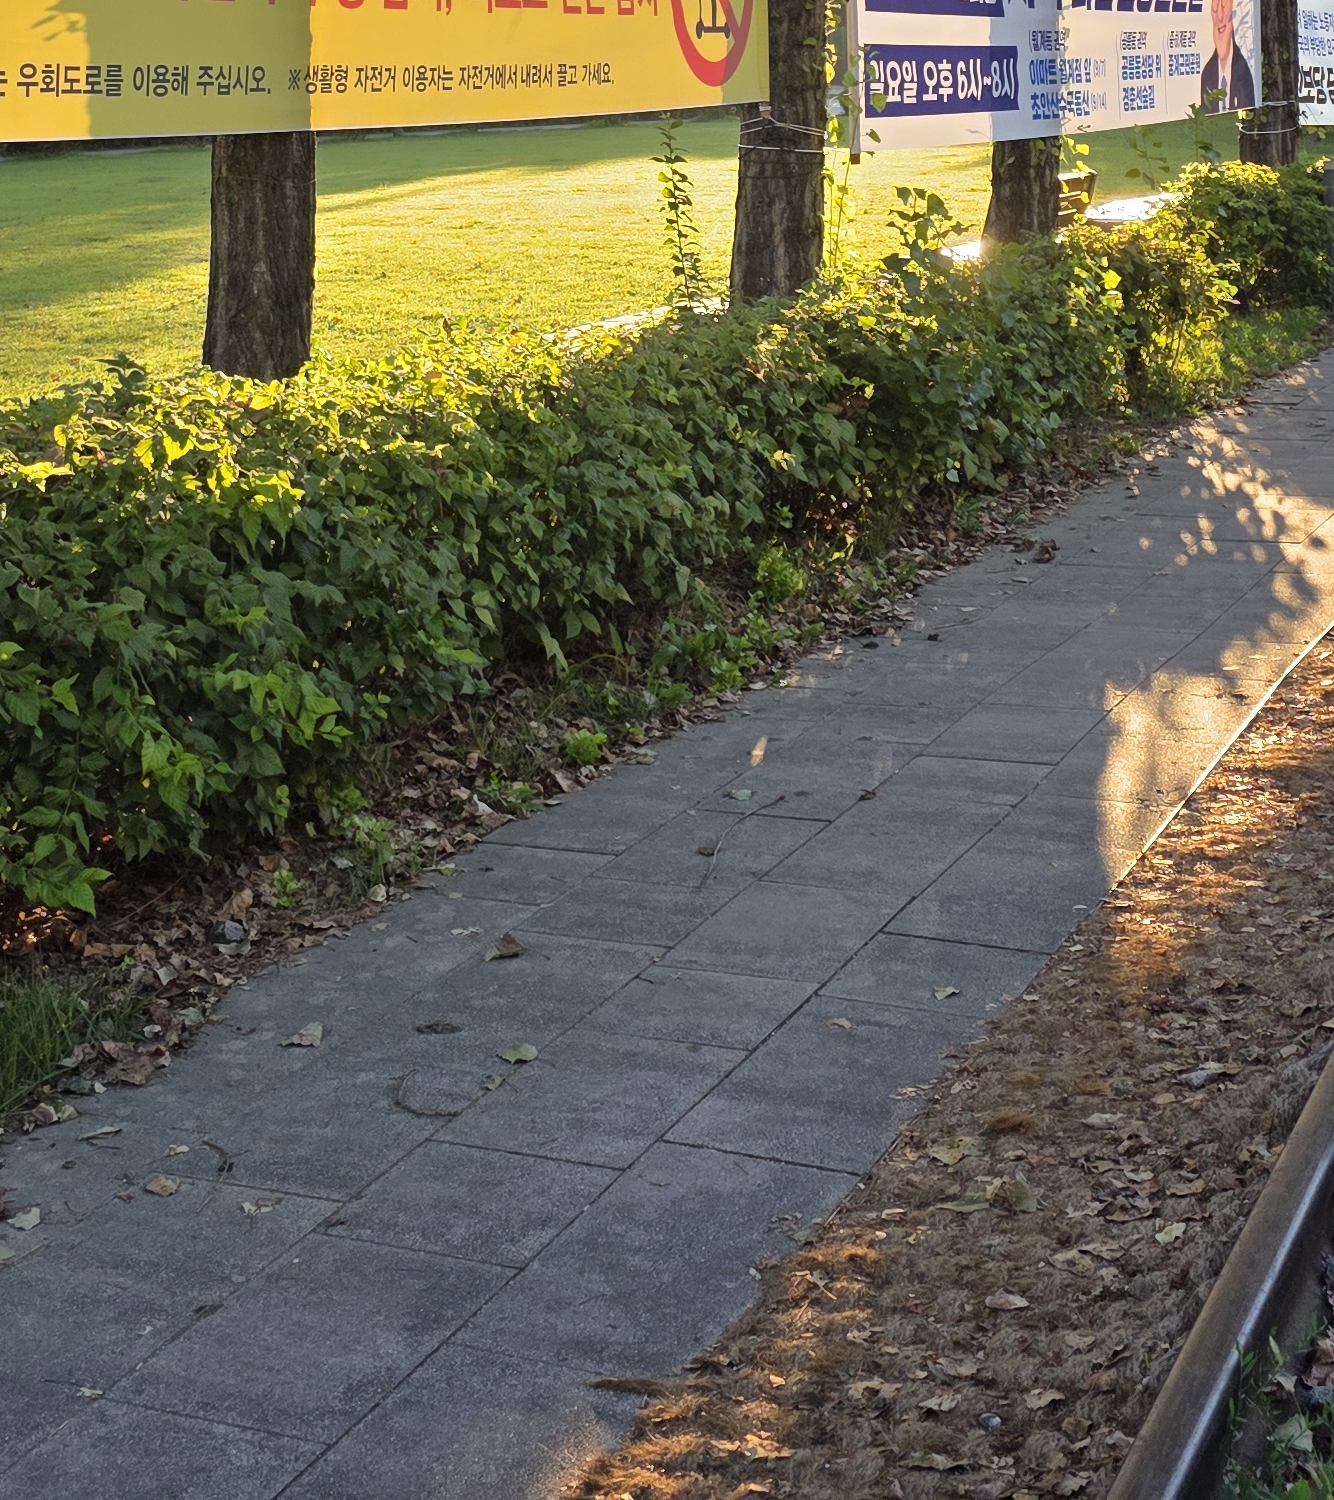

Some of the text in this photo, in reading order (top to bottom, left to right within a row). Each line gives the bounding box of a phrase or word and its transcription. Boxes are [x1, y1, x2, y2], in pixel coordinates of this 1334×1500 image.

[354, 64, 398, 94] 자전거
[402, 65, 454, 92] 이용자는
[458, 64, 517, 92] 자전거에서
[520, 64, 553, 90] 내려서
[557, 63, 577, 88] 끌고
[581, 63, 615, 87] 가세요.
[1028, 58, 1058, 86] 이마트
[1058, 57, 1083, 85] 월계점
[1083, 57, 1092, 83] 앞
[1121, 54, 1162, 81] 공릉동성당 위
[1168, 52, 1201, 77] 중계근린공원
[16, 62, 124, 97] 우회도로를
[133, 64, 189, 96] 이용해
[196, 64, 272, 96] 주십시오.
[922, 58, 954, 103] 오후
[956, 57, 1016, 101] 6시~8시
[1122, 85, 1156, 112] 경춘선숲길
